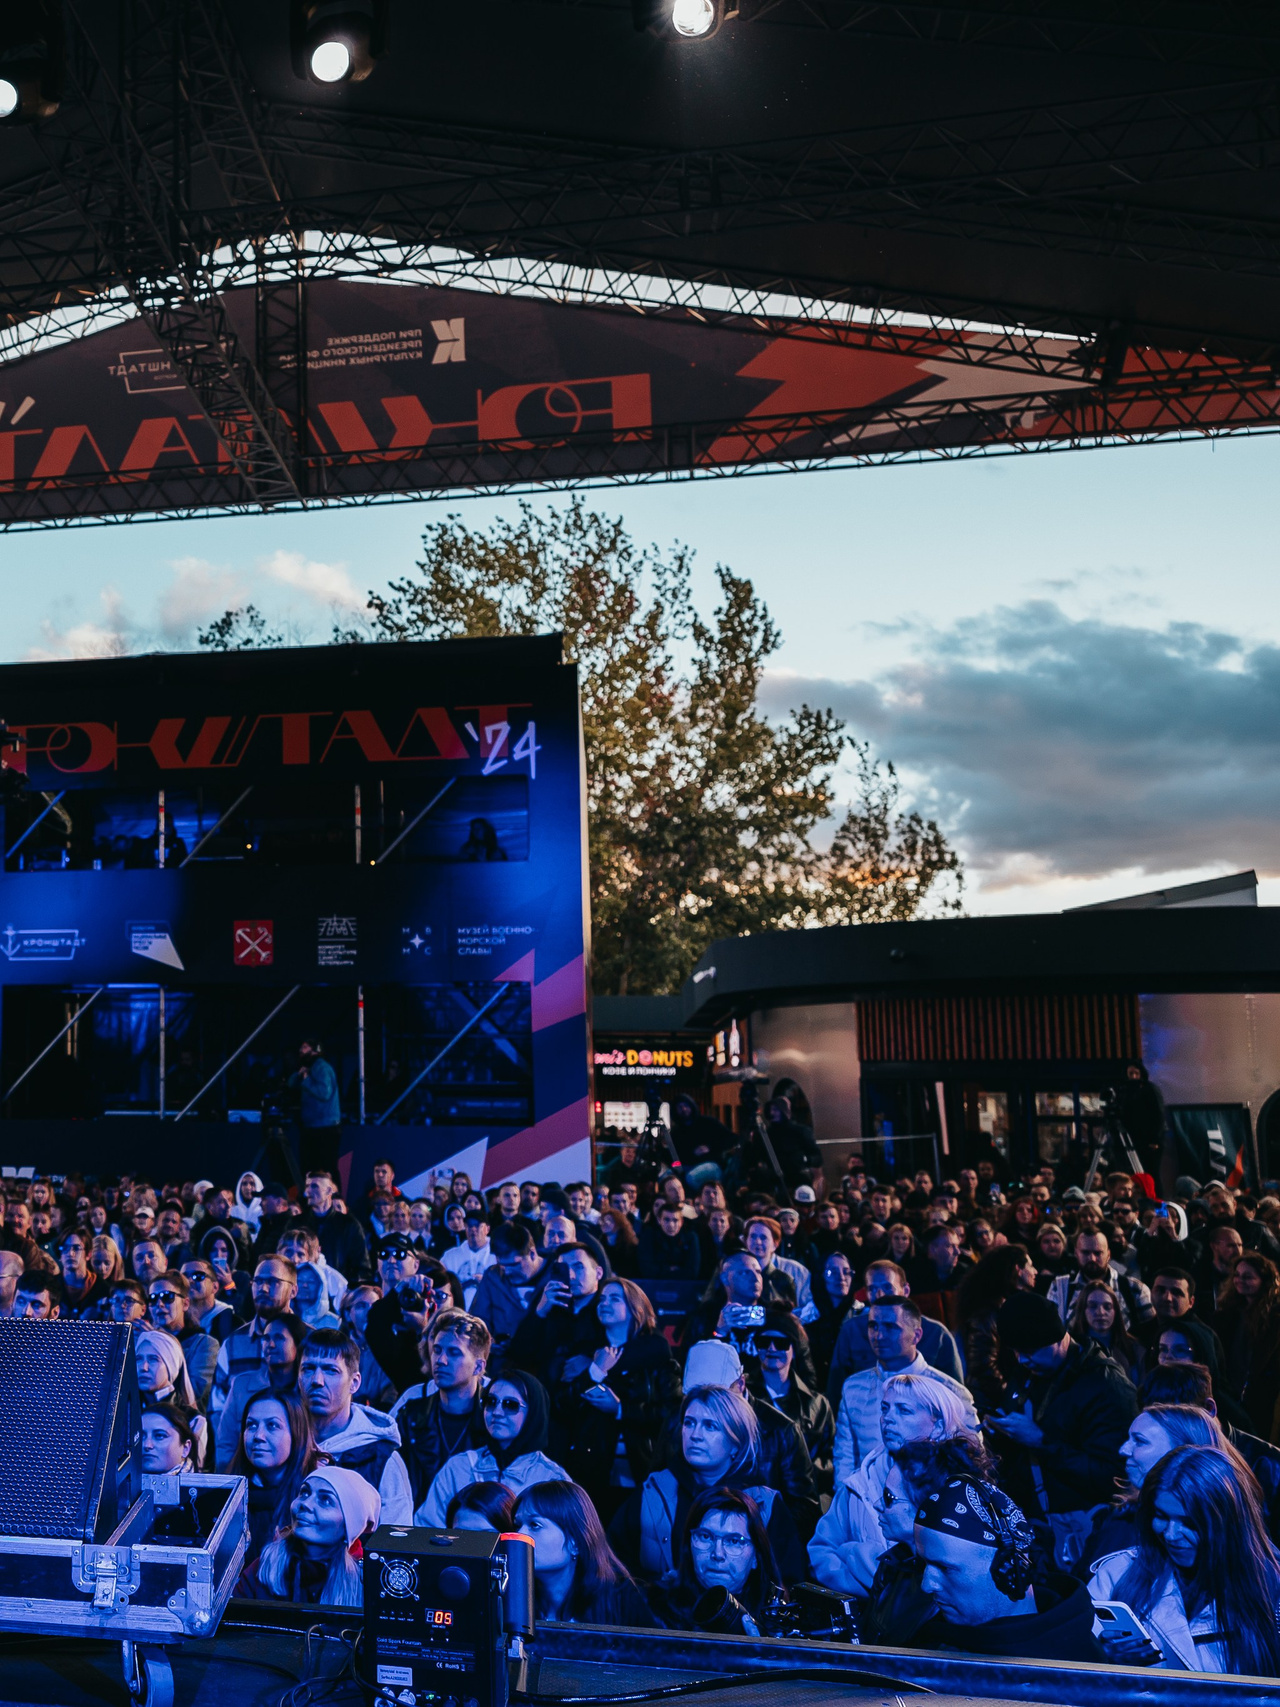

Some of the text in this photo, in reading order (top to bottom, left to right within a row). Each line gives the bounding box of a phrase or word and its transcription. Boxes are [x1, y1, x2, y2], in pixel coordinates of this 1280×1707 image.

[457, 924, 489, 935] МУЗЕЙ
[457, 935, 506, 945] МОРСКОЙ
[457, 946, 492, 956] СЛАВЫ
[626, 1049, 694, 1068] DONUTS
[376, 1636, 388, 1644] Cold
[444, 1662, 460, 1670] RoHS
